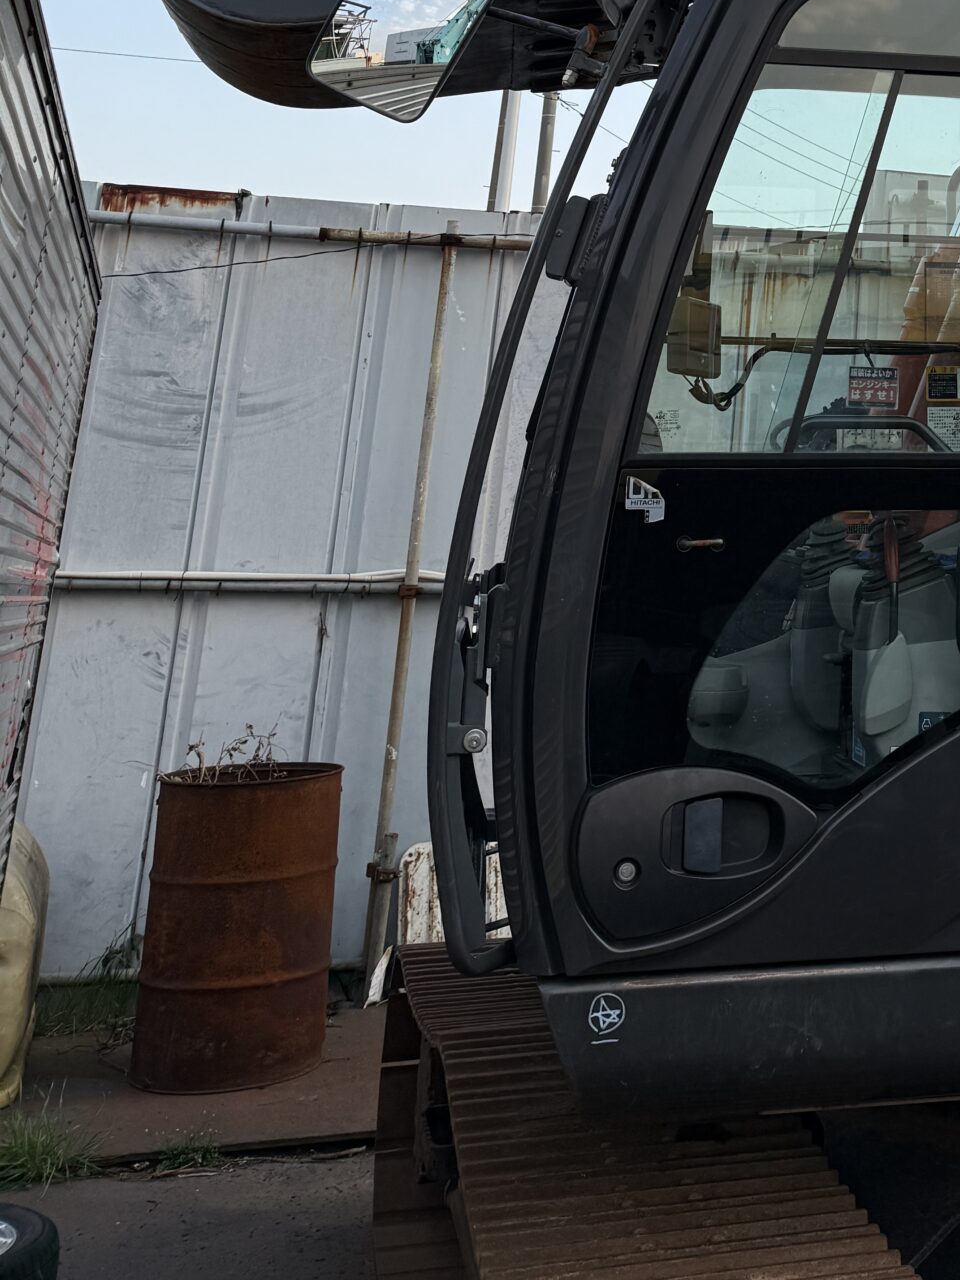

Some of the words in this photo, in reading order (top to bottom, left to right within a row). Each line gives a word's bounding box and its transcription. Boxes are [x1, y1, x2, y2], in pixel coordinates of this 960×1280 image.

[850, 380, 897, 389] エンジンキー
